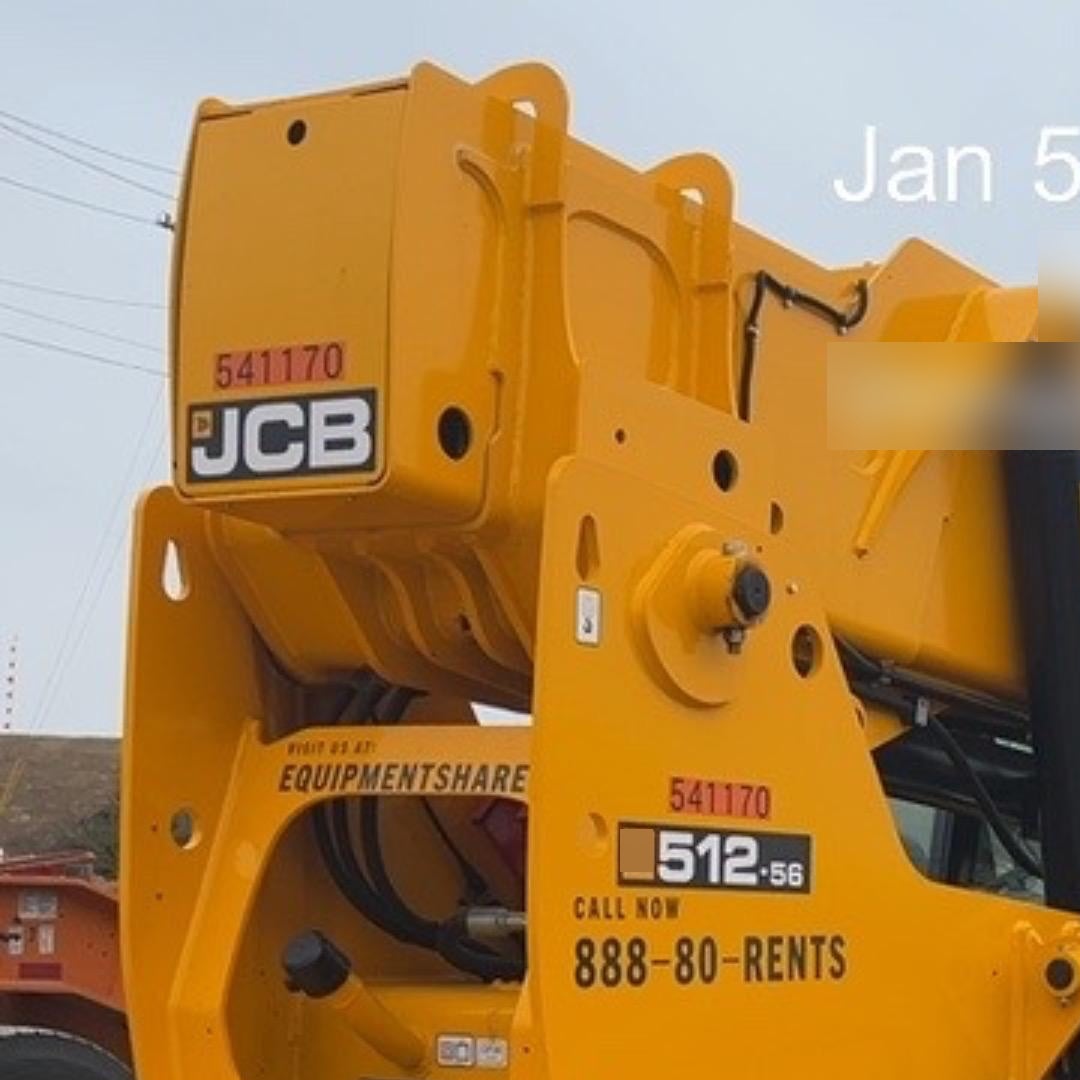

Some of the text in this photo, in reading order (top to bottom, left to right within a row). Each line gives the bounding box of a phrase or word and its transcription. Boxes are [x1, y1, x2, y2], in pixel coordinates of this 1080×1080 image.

[216, 342, 343, 388] 541170
[192, 398, 372, 476] JCB
[278, 764, 529, 792] EQUIPMENTSHARE
[670, 777, 771, 819] 541170
[573, 896, 680, 919] CALL NOW
[575, 936, 847, 988] 888-80-RENTS
